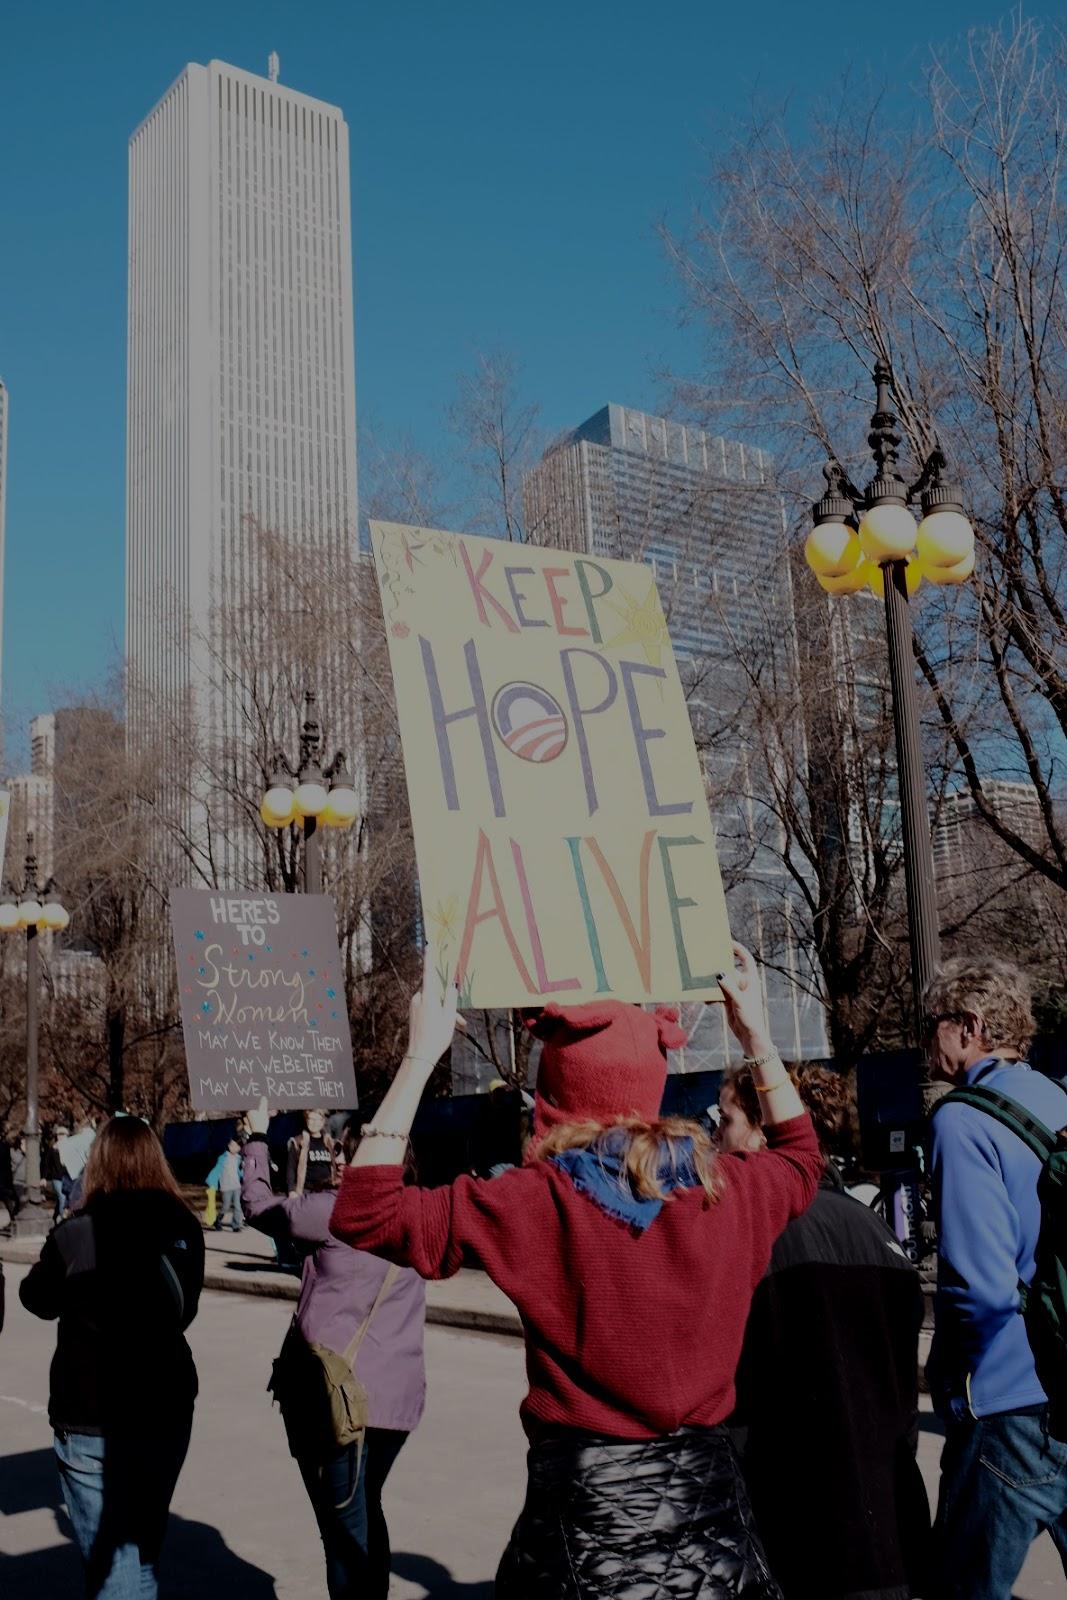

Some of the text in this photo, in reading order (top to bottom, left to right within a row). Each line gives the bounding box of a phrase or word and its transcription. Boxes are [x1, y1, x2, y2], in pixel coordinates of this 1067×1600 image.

[459, 540, 613, 643] KEEP
[418, 634, 694, 817] HOPE
[454, 827, 720, 994] ALIVE
[236, 924, 265, 946] TO
[196, 944, 314, 1010] Strong
[206, 990, 311, 1025] Women
[199, 1030, 343, 1051] MAY WE KNOW THEM
[225, 1057, 254, 1074] MAY
[300, 1053, 333, 1073] THEM
[200, 1076, 345, 1098] MAY WE RAISE THEM
